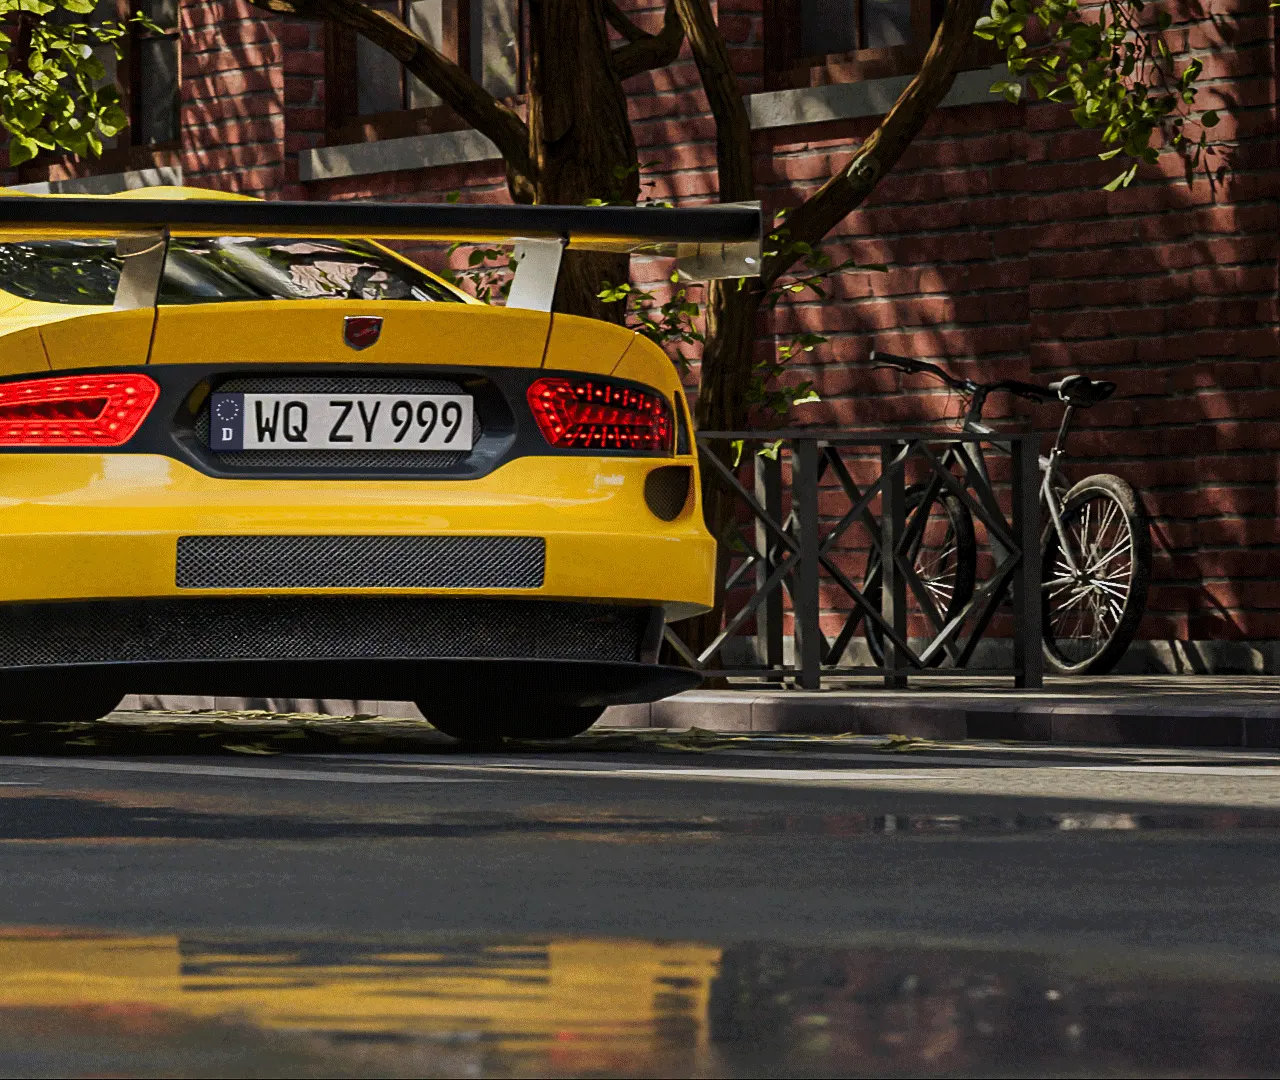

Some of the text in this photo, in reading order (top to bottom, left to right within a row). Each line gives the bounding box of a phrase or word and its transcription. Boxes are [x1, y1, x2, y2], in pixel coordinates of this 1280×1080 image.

[221, 427, 233, 441] D
[255, 400, 462, 443] WQ ZY 999
